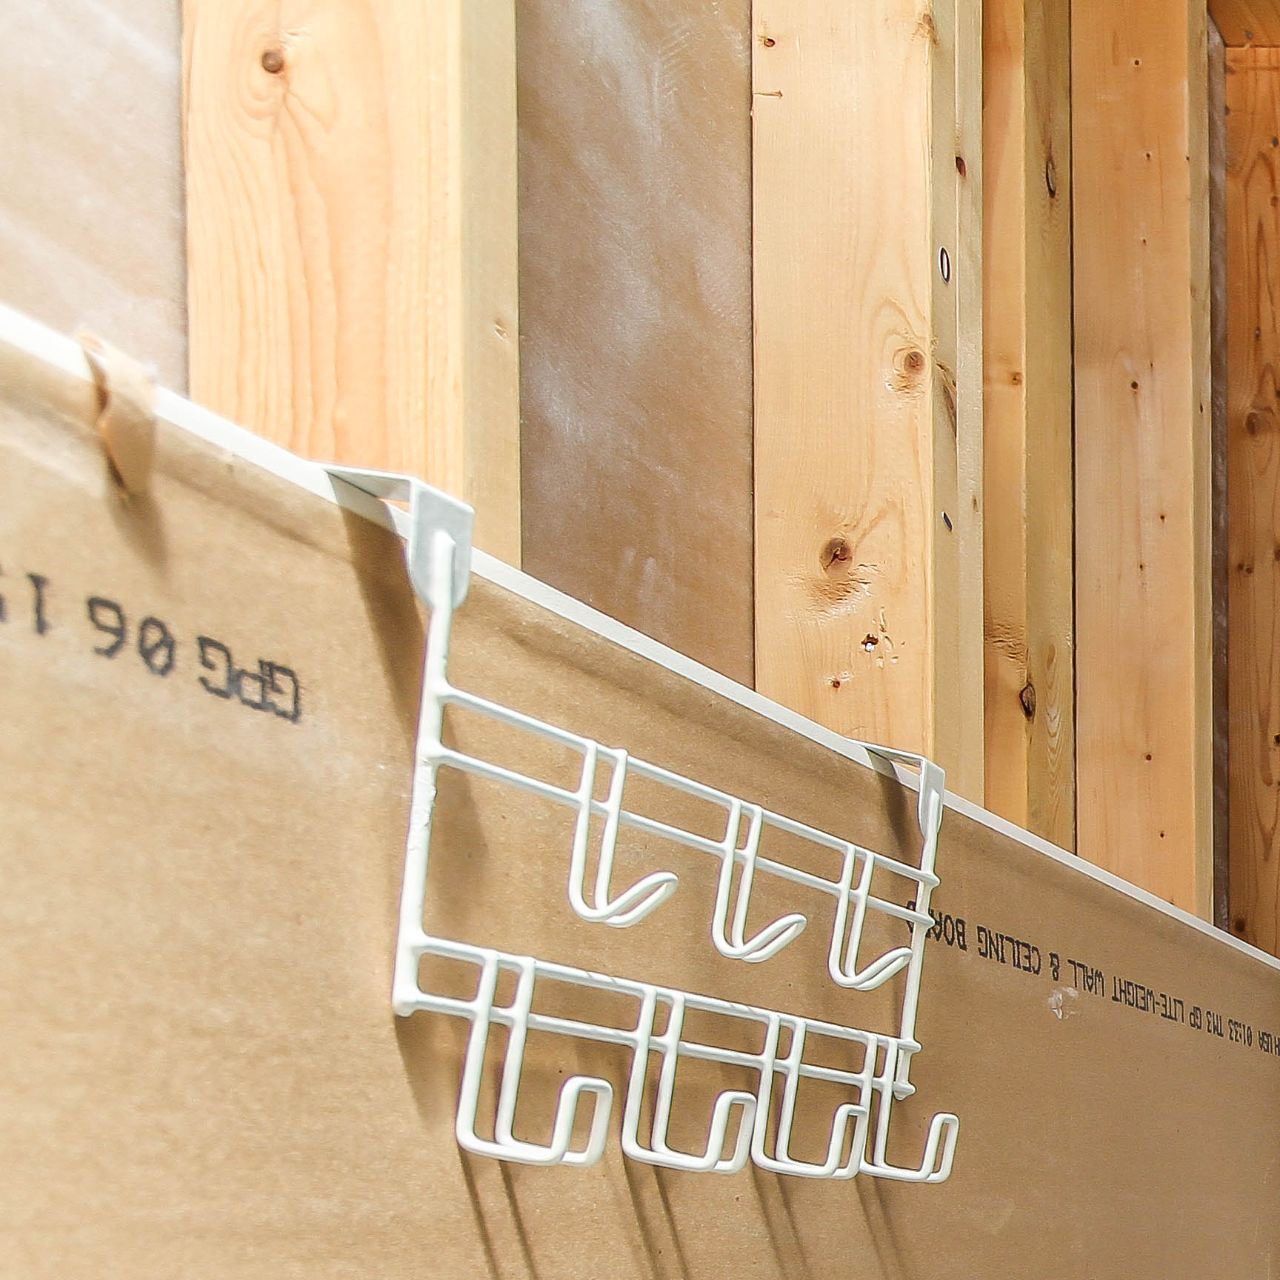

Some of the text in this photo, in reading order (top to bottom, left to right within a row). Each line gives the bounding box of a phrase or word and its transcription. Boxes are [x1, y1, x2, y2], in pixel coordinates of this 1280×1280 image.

[906, 900, 968, 953] BOA
[976, 926, 1042, 976] CEILING
[1048, 952, 1060, 982] &
[1067, 959, 1105, 998] WALL
[1111, 976, 1185, 1024] LITE-WEIGHT
[1189, 1005, 1203, 1031] GP
